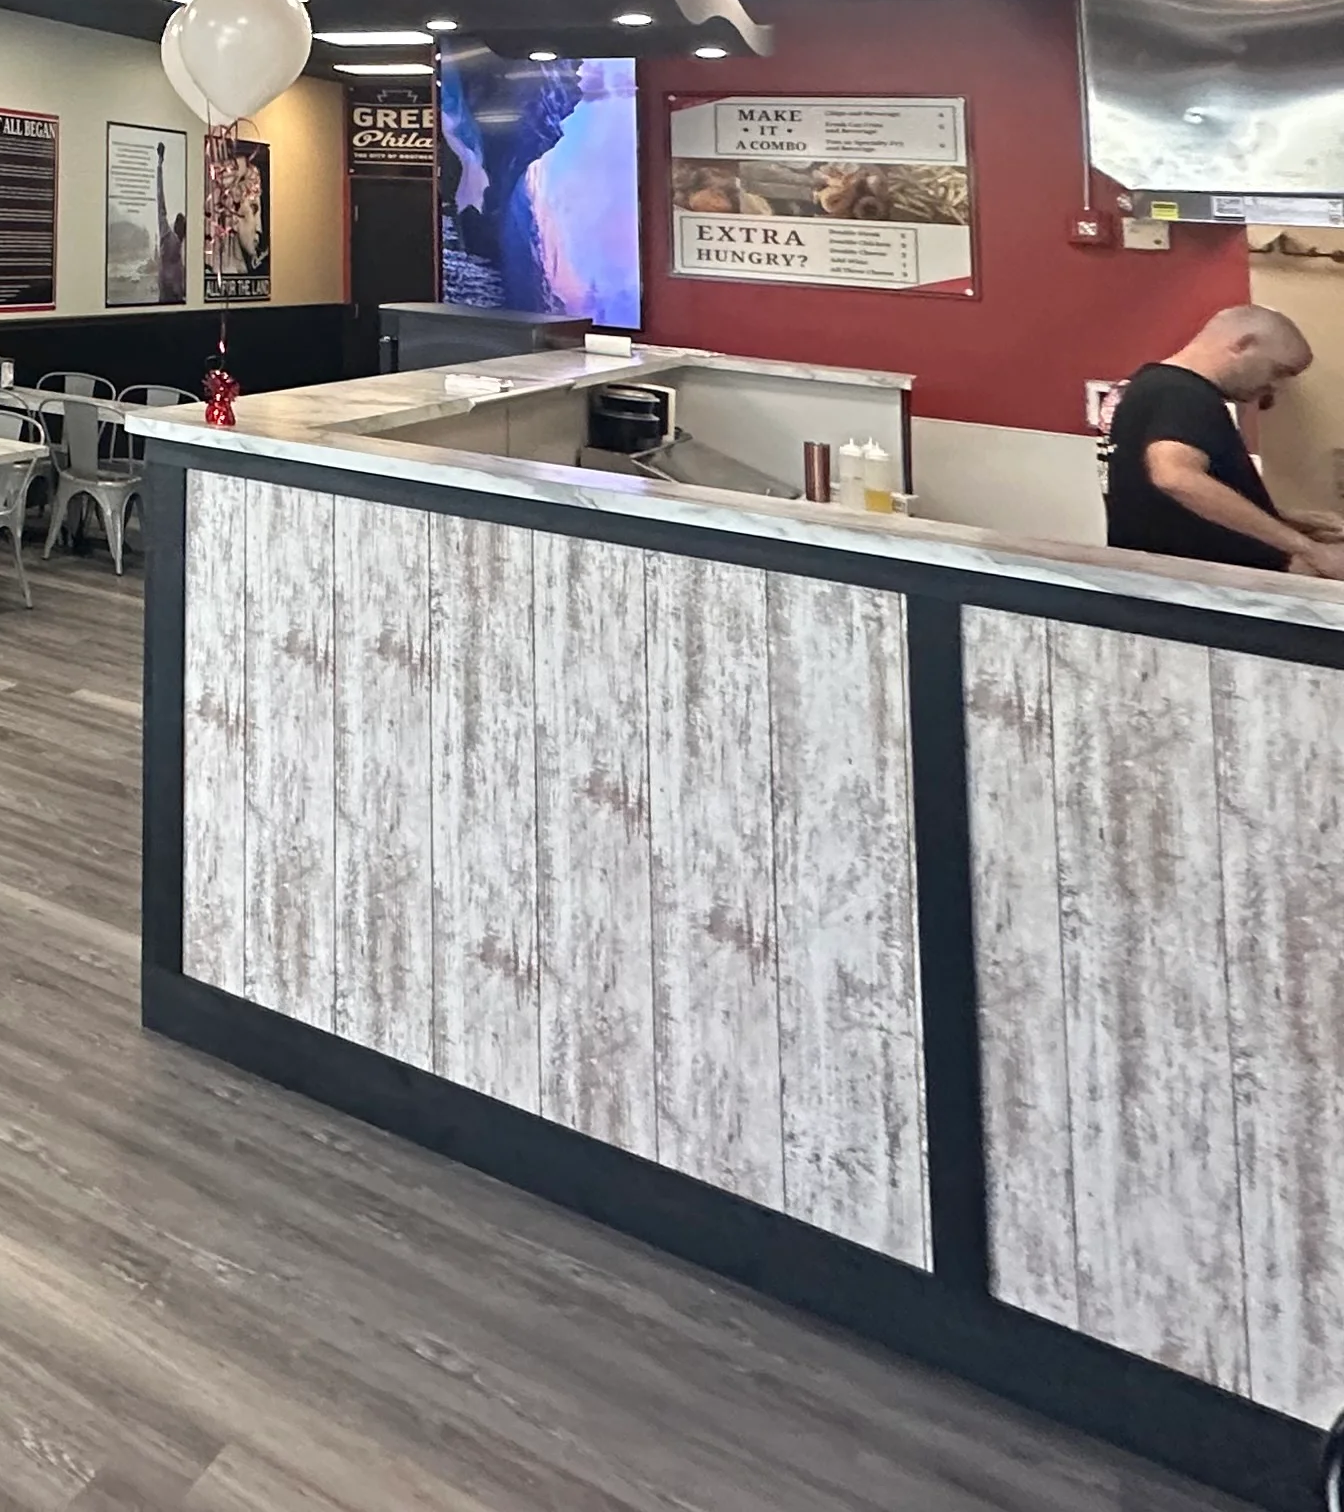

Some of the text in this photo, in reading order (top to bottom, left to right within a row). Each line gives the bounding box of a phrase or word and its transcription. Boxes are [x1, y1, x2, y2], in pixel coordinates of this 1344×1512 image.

[738, 109, 803, 122] MAKE
[3, 118, 23, 136] ALL
[24, 120, 56, 139] BEGAN
[760, 125, 778, 136] IT
[736, 139, 807, 151] A COMBO
[696, 224, 806, 246] EXTRA
[696, 248, 808, 267] HUNGRY?
